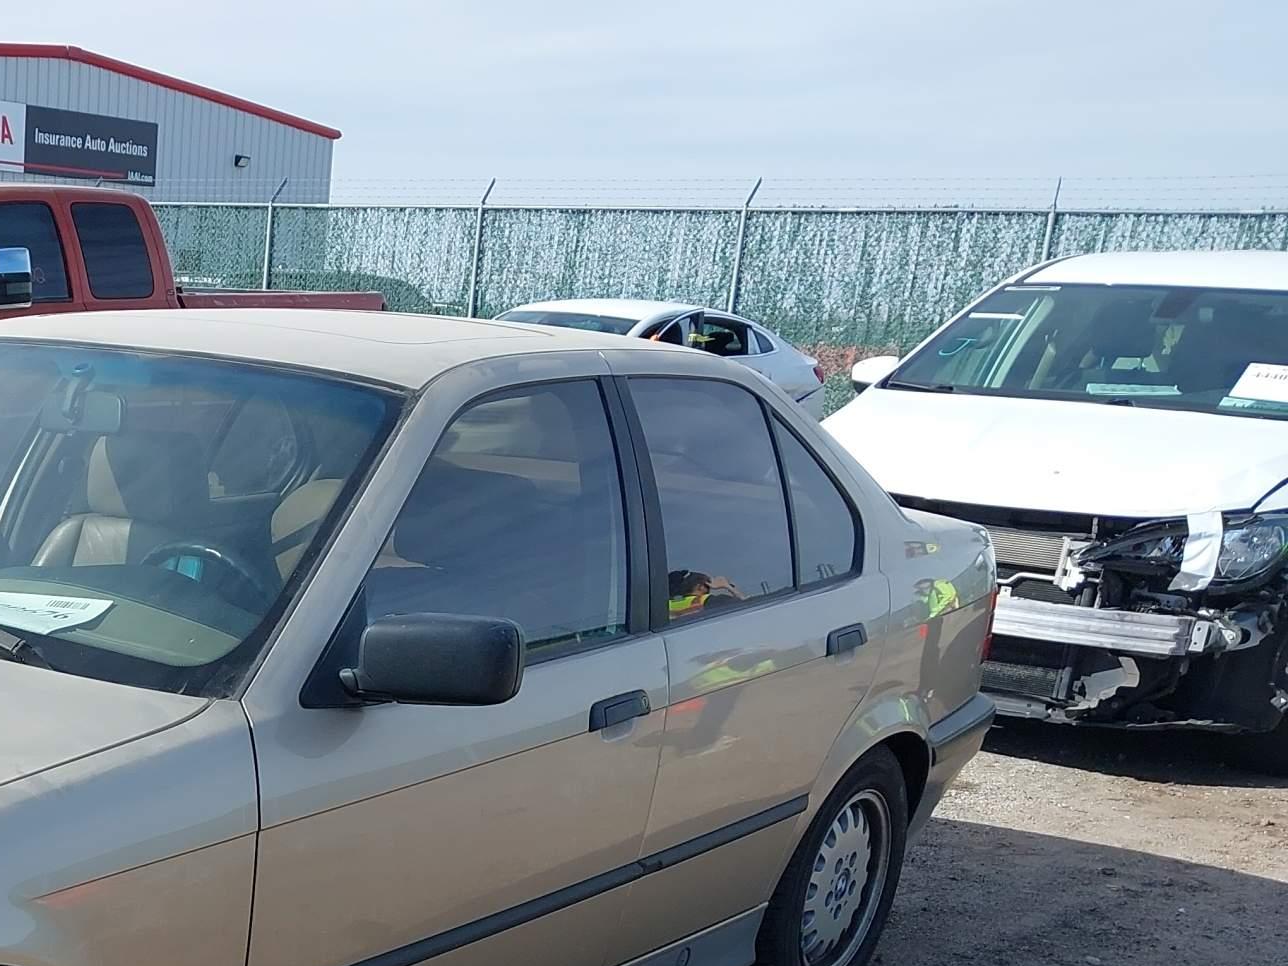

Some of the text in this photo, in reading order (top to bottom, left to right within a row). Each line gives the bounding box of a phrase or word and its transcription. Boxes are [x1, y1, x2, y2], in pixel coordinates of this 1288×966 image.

[34, 127, 148, 157] Insurance Auto Auctions
